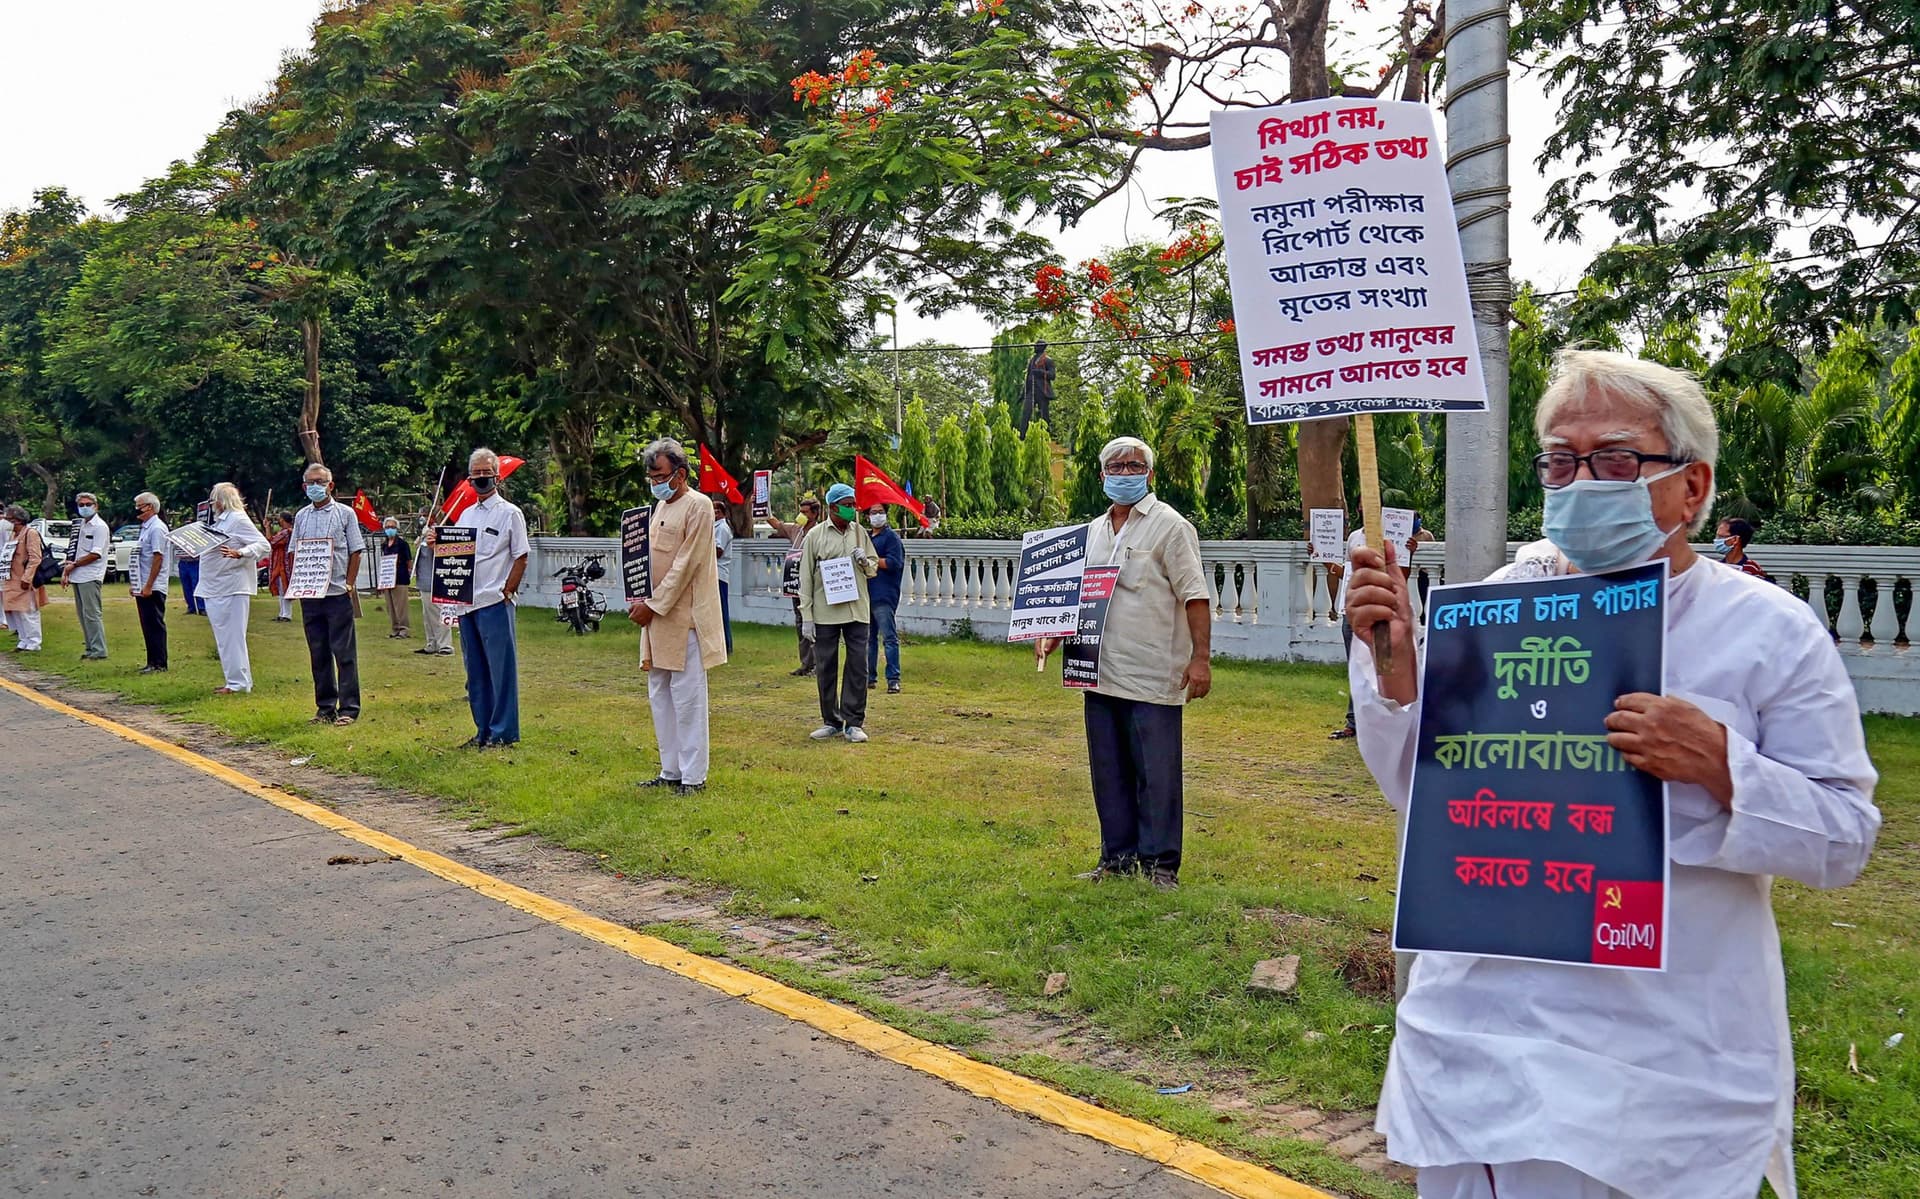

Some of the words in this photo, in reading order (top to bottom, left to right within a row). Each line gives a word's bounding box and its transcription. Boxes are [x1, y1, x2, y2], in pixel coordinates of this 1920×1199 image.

[1257, 109, 1330, 149] মিথ্যা
[1336, 106, 1385, 130] নয়,
[1234, 157, 1283, 191] চাই
[1290, 139, 1369, 176] সঠিক
[1374, 136, 1428, 160] তথ্য
[1250, 198, 1316, 228] নমুনা
[1323, 187, 1425, 215] পরীক্ষার
[1262, 219, 1351, 255] রিপোর্ট
[1359, 224, 1425, 244] থেকে
[1269, 257, 1367, 284] আক্রান্ত
[1375, 255, 1429, 276] এবং
[1279, 290, 1351, 322] মৃতের
[1357, 286, 1427, 309] সংখ্যা
[1252, 341, 1311, 367] সমস্ত
[1316, 331, 1365, 354] তথ্য
[1370, 325, 1455, 353] মানুষের
[1259, 369, 1333, 398] সামনে
[1340, 359, 1421, 384] আনতে
[1426, 356, 1468, 378] হবে
[1024, 556, 1062, 575] কারখানা
[1012, 616, 1033, 630] মানুষ
[1035, 614, 1056, 625] খাবে
[1058, 612, 1077, 624] কী?
[1434, 598, 1522, 630] রেশনের
[1533, 593, 1580, 622] চাল
[1592, 579, 1659, 617] পাচার
[1493, 636, 1592, 700] দুর্নীতি
[1530, 700, 1548, 720] ও
[1435, 730, 1636, 772] কালোবাজা
[1448, 788, 1556, 830] অবিলম্বে
[1568, 803, 1615, 835] বন্ধ
[1455, 856, 1531, 888] করতে
[1543, 860, 1595, 894] হবে
[1596, 923, 1655, 951] Cpi(M)
